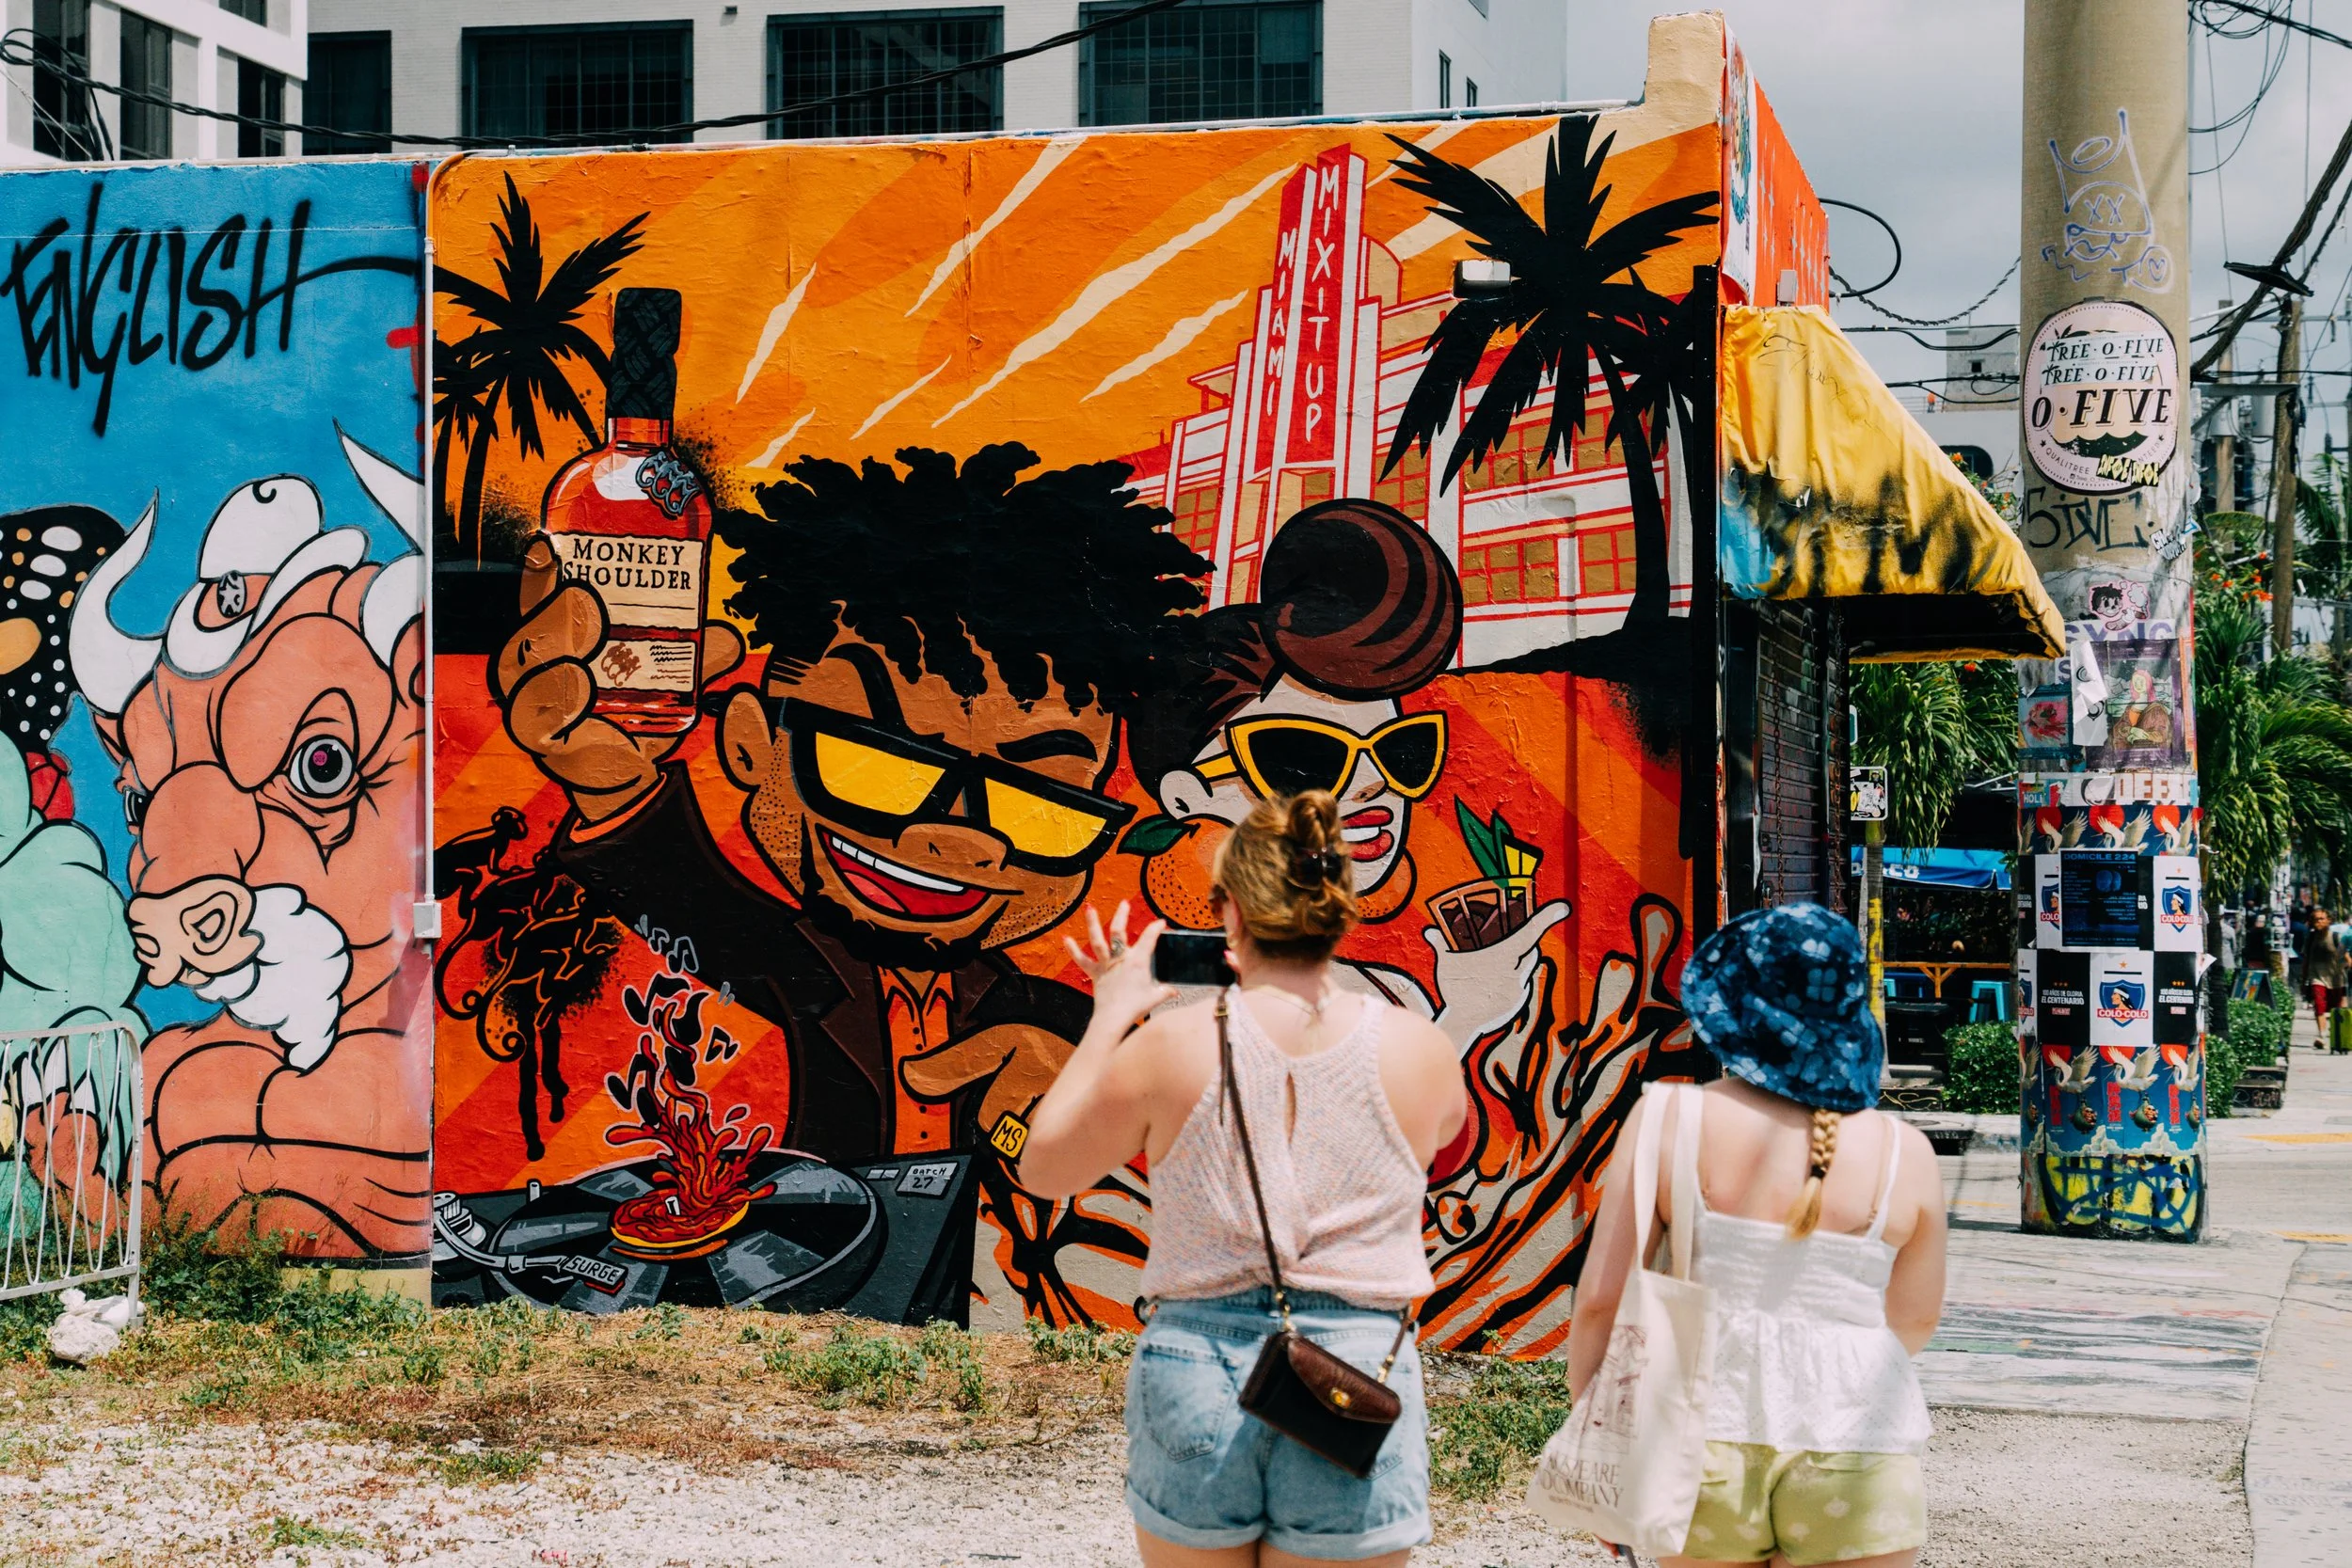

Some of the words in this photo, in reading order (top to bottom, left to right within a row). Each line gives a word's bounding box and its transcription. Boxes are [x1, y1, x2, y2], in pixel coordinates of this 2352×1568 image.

[0, 182, 419, 437] ENGLISH
[1267, 228, 1297, 417] MIAMI
[2070, 388, 2171, 425] FIVE
[2045, 447, 2090, 475] QUALITREE
[572, 538, 685, 566] MONKEY
[563, 562, 691, 590] SHOULDER
[2047, 996, 2085, 1006] CENTENARIO
[992, 1119, 1024, 1152] MS
[912, 1167, 947, 1176] BATCH
[912, 1176, 934, 1189] 27
[565, 1257, 620, 1283] SURGE
